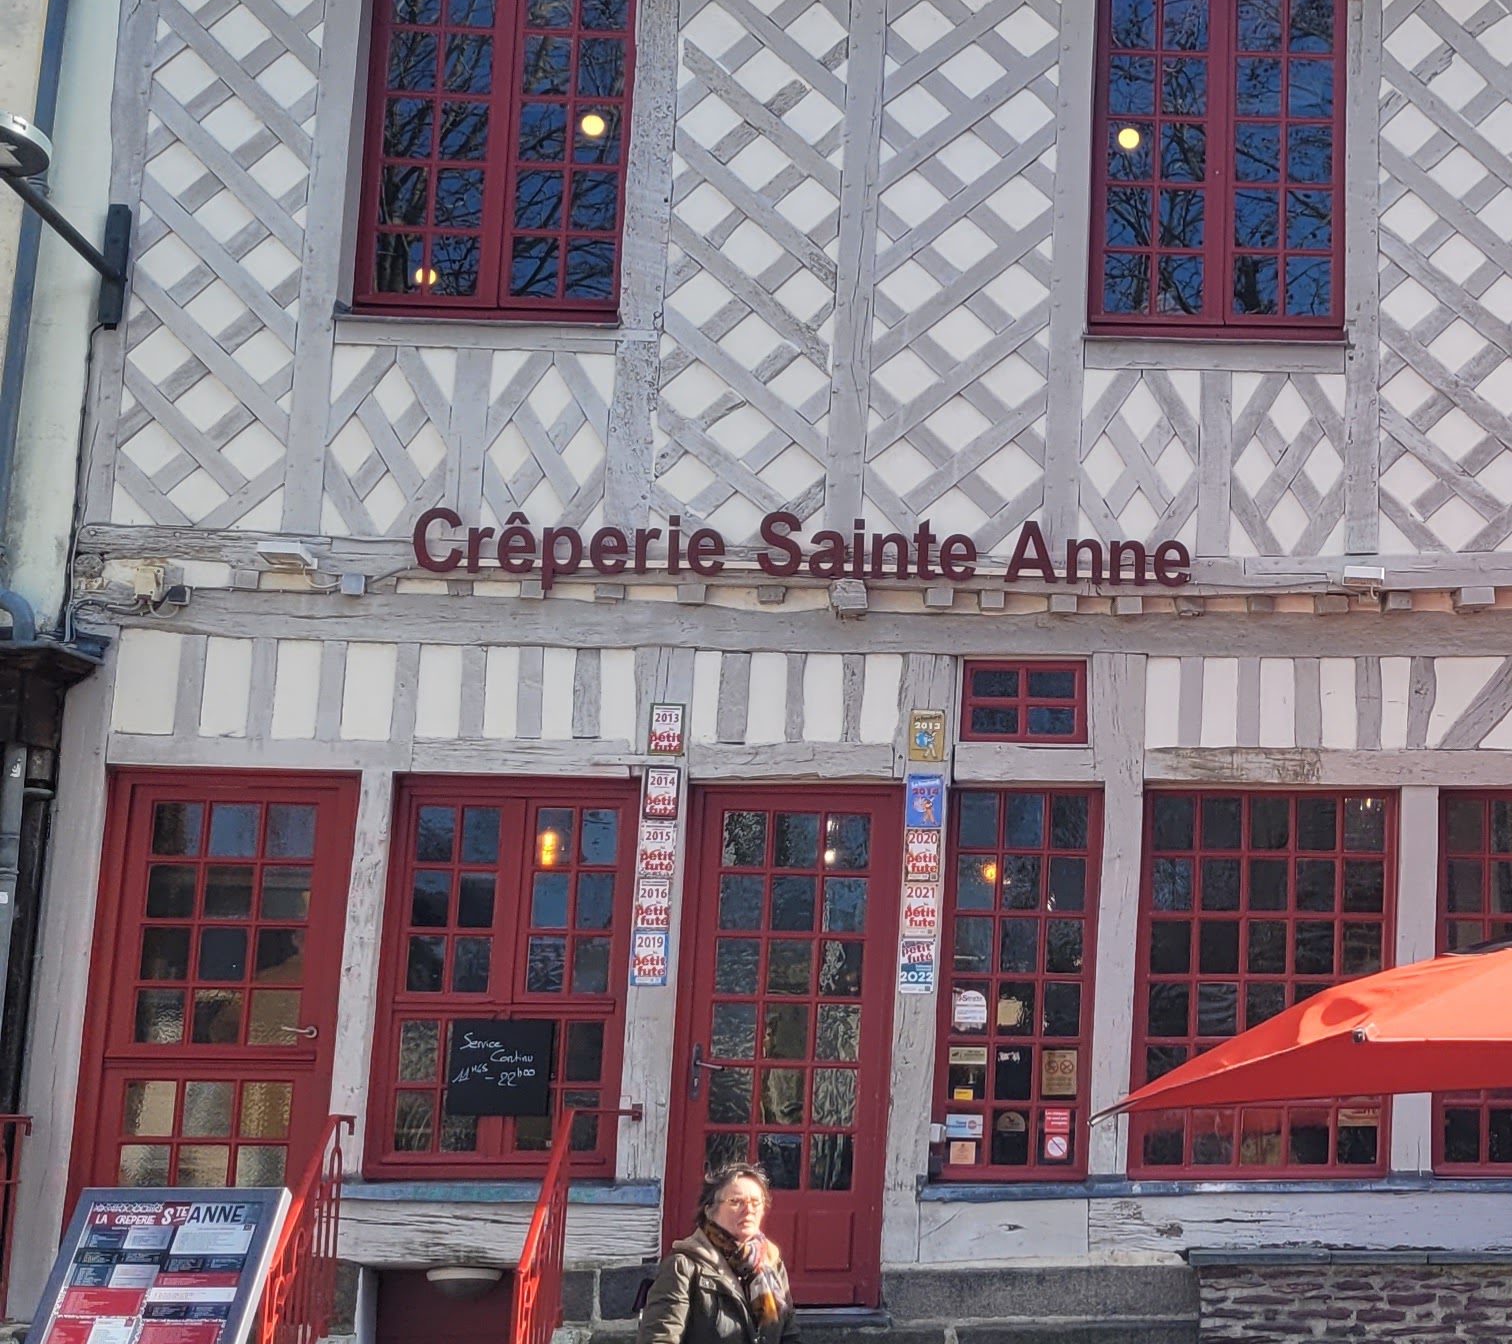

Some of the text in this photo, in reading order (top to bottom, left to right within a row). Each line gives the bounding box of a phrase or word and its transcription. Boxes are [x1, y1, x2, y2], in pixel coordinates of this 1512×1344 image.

[412, 506, 1192, 590] Crêperie Sainte Anne
[655, 713, 679, 723] 2013
[650, 776, 675, 787] 2014
[645, 831, 671, 841] 2015
[908, 832, 938, 844] 2020
[640, 849, 674, 863] petit
[906, 853, 938, 865] petit
[640, 888, 667, 899] 2016
[906, 887, 935, 898] 2021
[635, 904, 670, 918] petit
[905, 906, 936, 919] petit
[637, 936, 664, 948] 2019
[902, 943, 932, 957] petit
[632, 955, 666, 968] petit
[900, 971, 933, 982] 2022
[460, 1032, 503, 1049] Service
[490, 1049, 533, 1063] Continu
[95, 1214, 108, 1224] LA
[187, 1205, 246, 1224] ANNE
